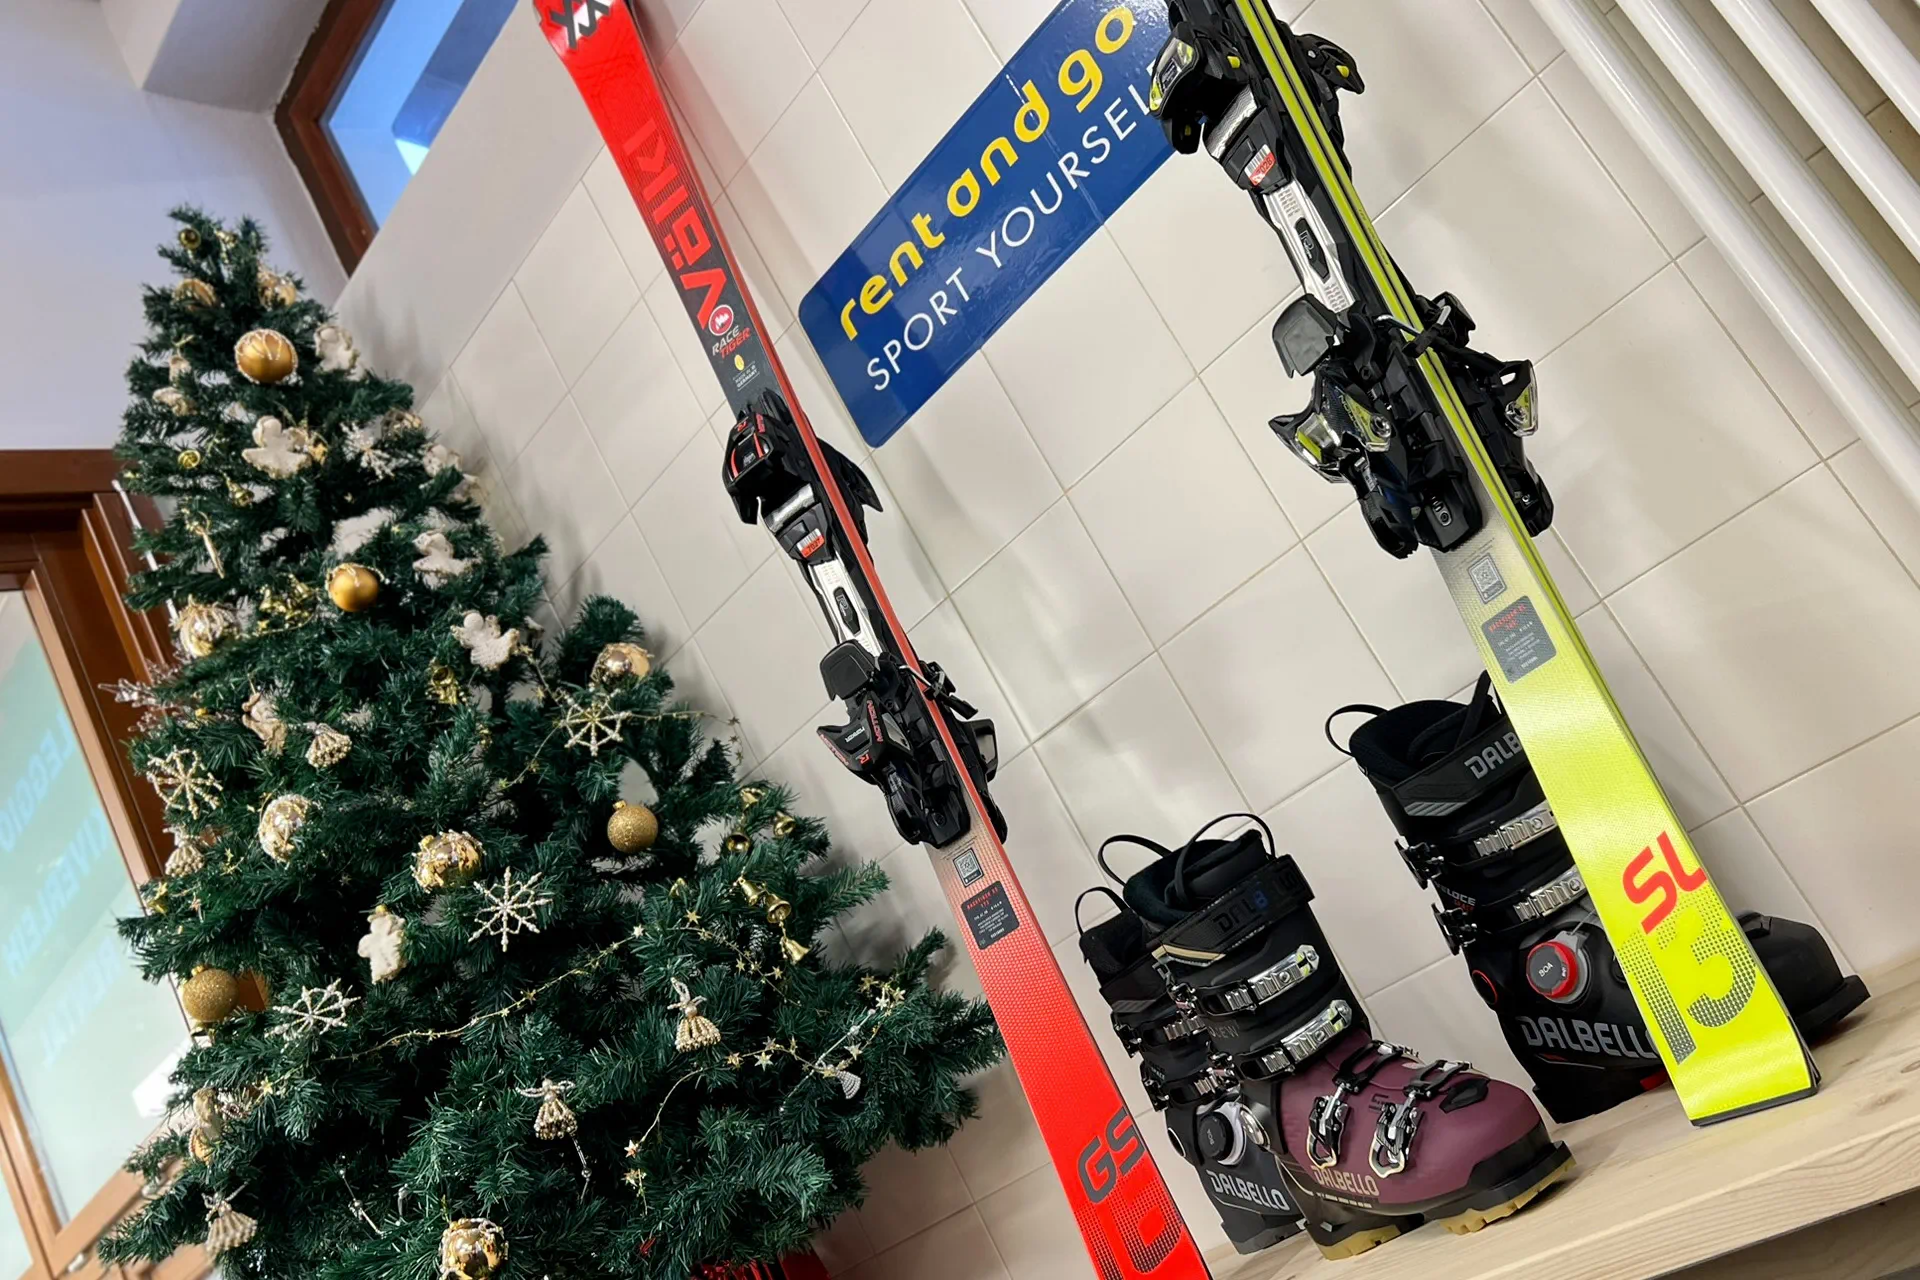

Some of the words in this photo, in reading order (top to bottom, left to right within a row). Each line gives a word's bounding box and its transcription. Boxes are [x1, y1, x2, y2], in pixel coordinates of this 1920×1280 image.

[840, 213, 945, 340] rent
[948, 82, 1050, 216] and
[1059, 5, 1133, 113] go
[621, 117, 728, 330] Völkl
[867, 263, 970, 391] SPORT
[974, 59, 1157, 269] YOURSEL
[711, 325, 739, 355] RACE
[720, 327, 751, 359] TIGER
[1463, 731, 1522, 780] DALB
[1622, 830, 1708, 935] SL
[1538, 962, 1554, 978] BOA
[1617, 885, 1757, 1066] 13
[1077, 1106, 1147, 1204] GS
[1206, 1169, 1291, 1212] DALBELLO
[1310, 1164, 1380, 1197] DALBELLO
